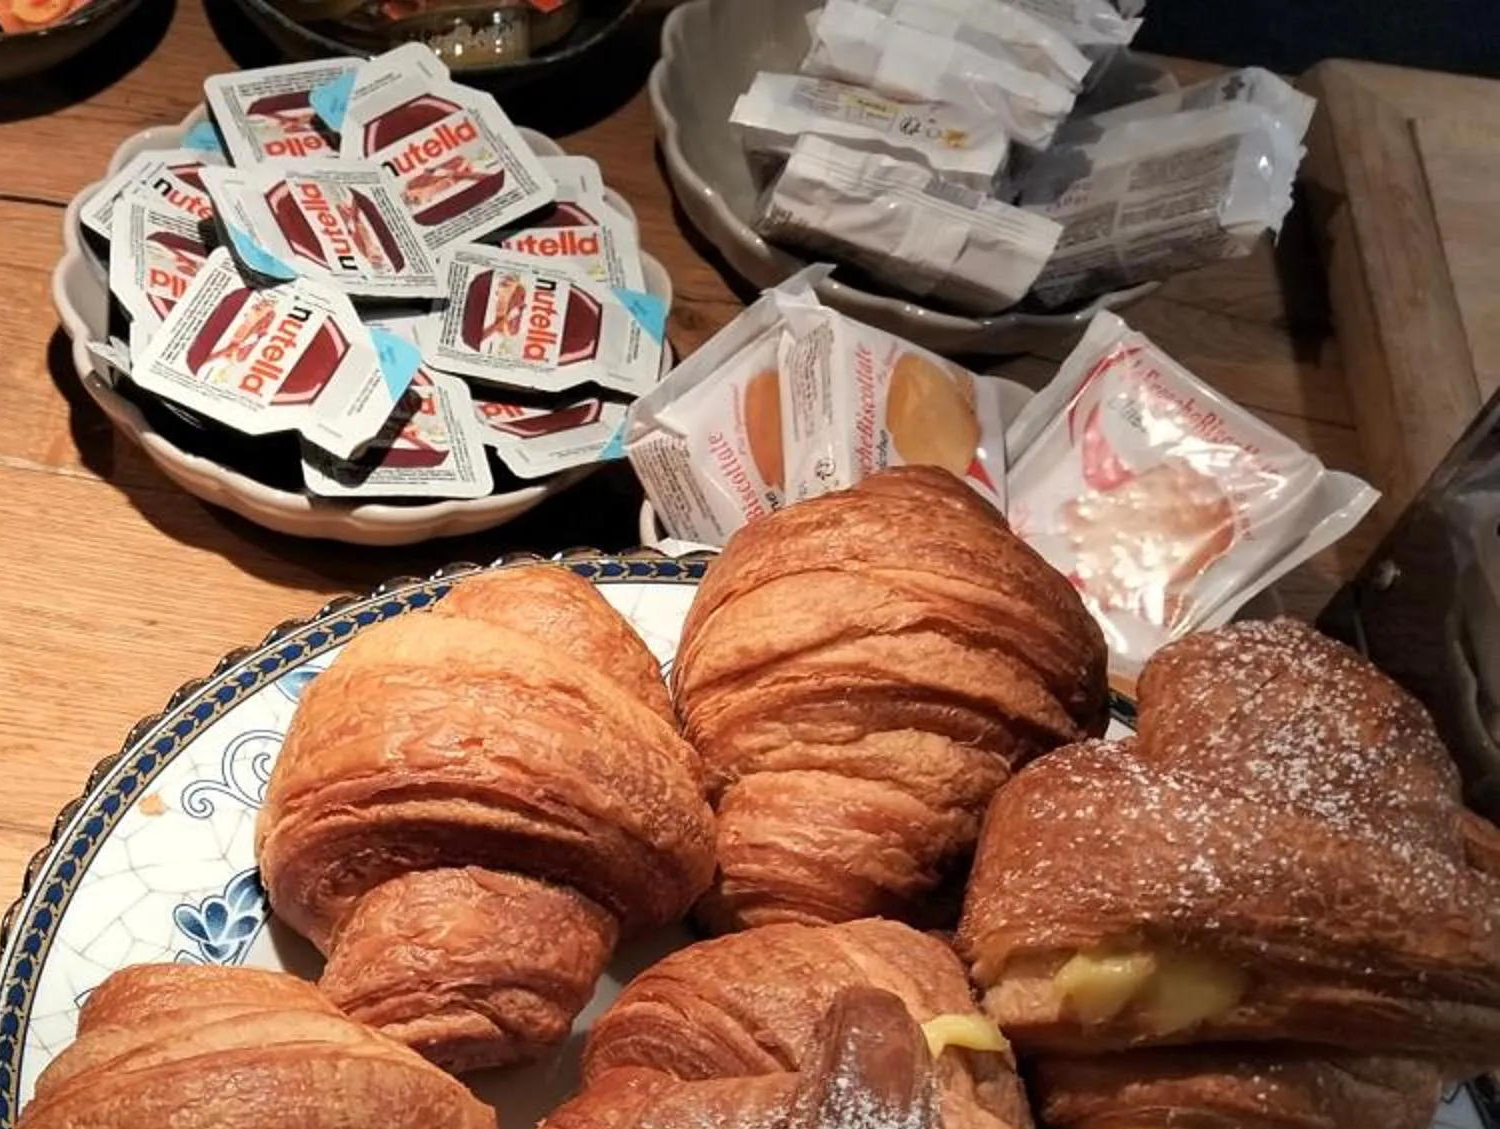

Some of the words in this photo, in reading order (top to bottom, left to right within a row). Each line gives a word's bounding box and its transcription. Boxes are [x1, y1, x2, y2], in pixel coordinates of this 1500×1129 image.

[153, 177, 213, 220] nute
[298, 182, 358, 271] nutella
[239, 305, 312, 396] nutella
[522, 278, 557, 362] nutella
